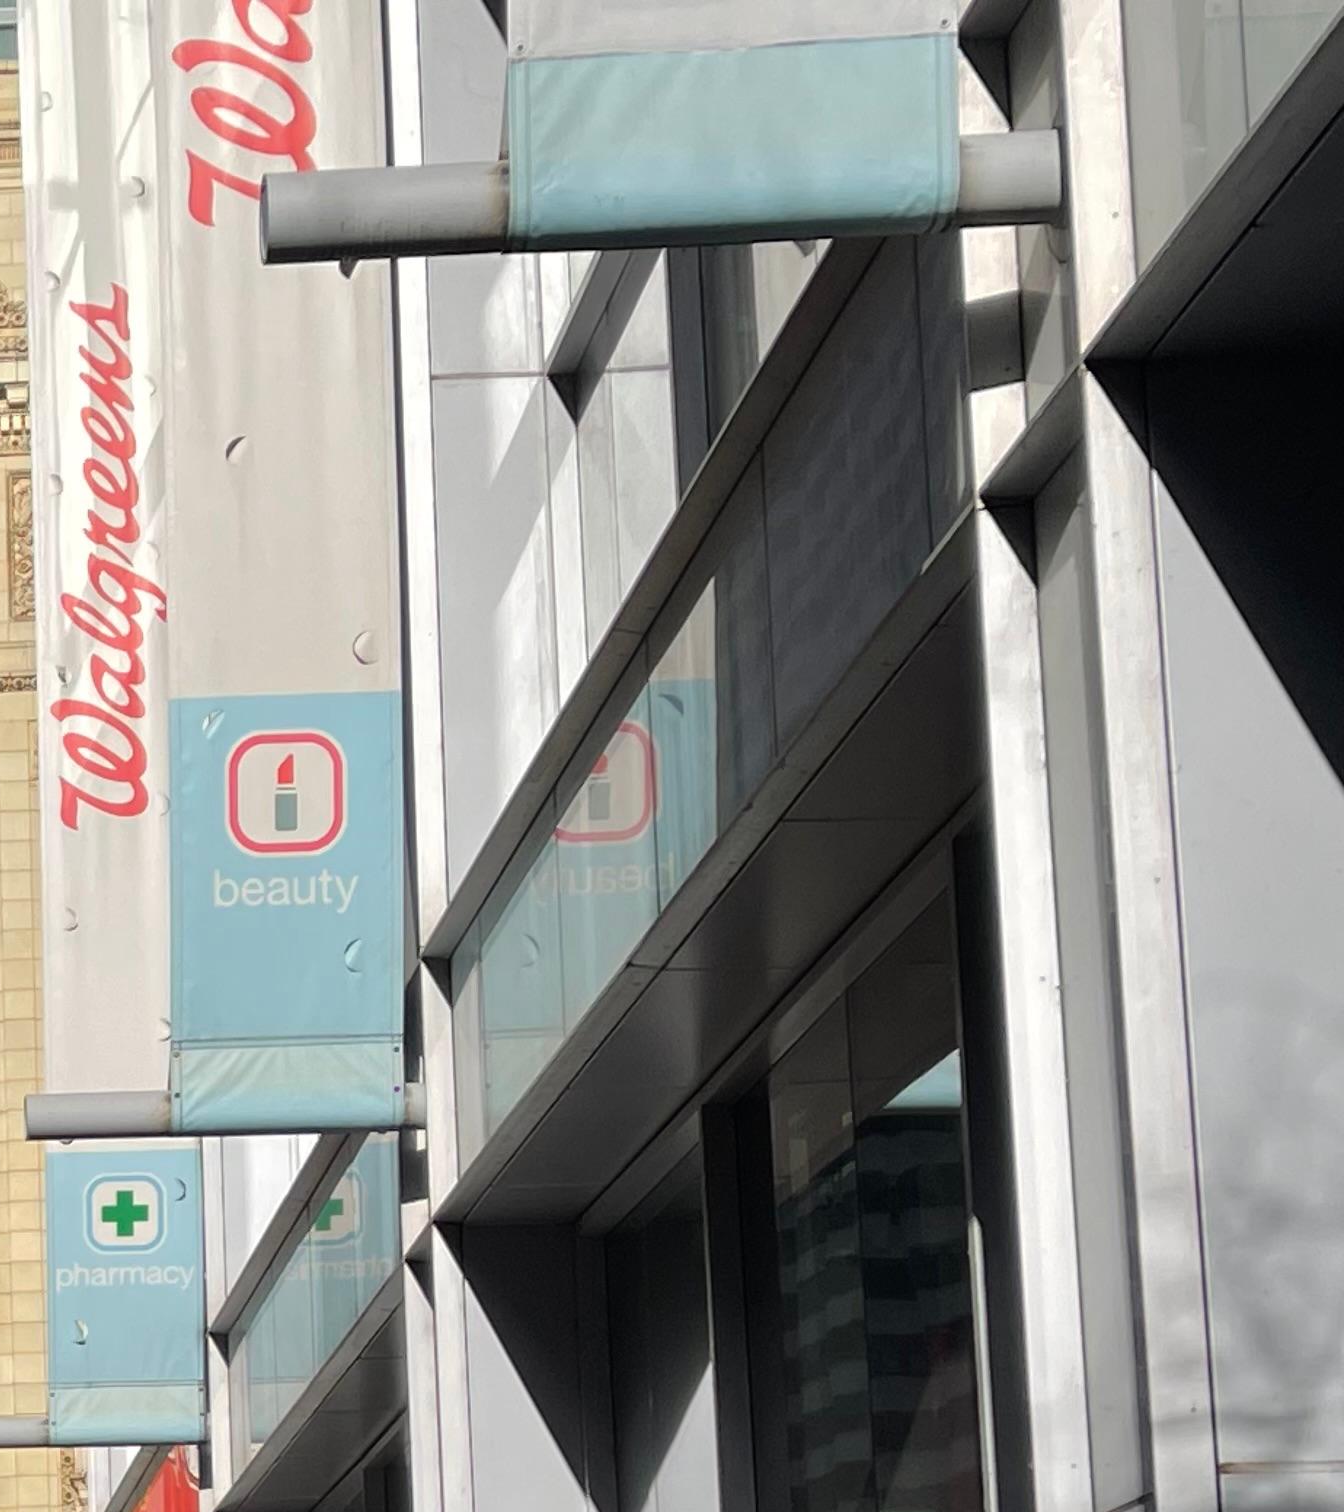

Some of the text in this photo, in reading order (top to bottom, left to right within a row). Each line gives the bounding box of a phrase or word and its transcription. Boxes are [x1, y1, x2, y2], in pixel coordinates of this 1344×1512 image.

[51, 282, 168, 832] Walgreens
[213, 869, 358, 913] beauty
[55, 1260, 195, 1290] pharmacy
